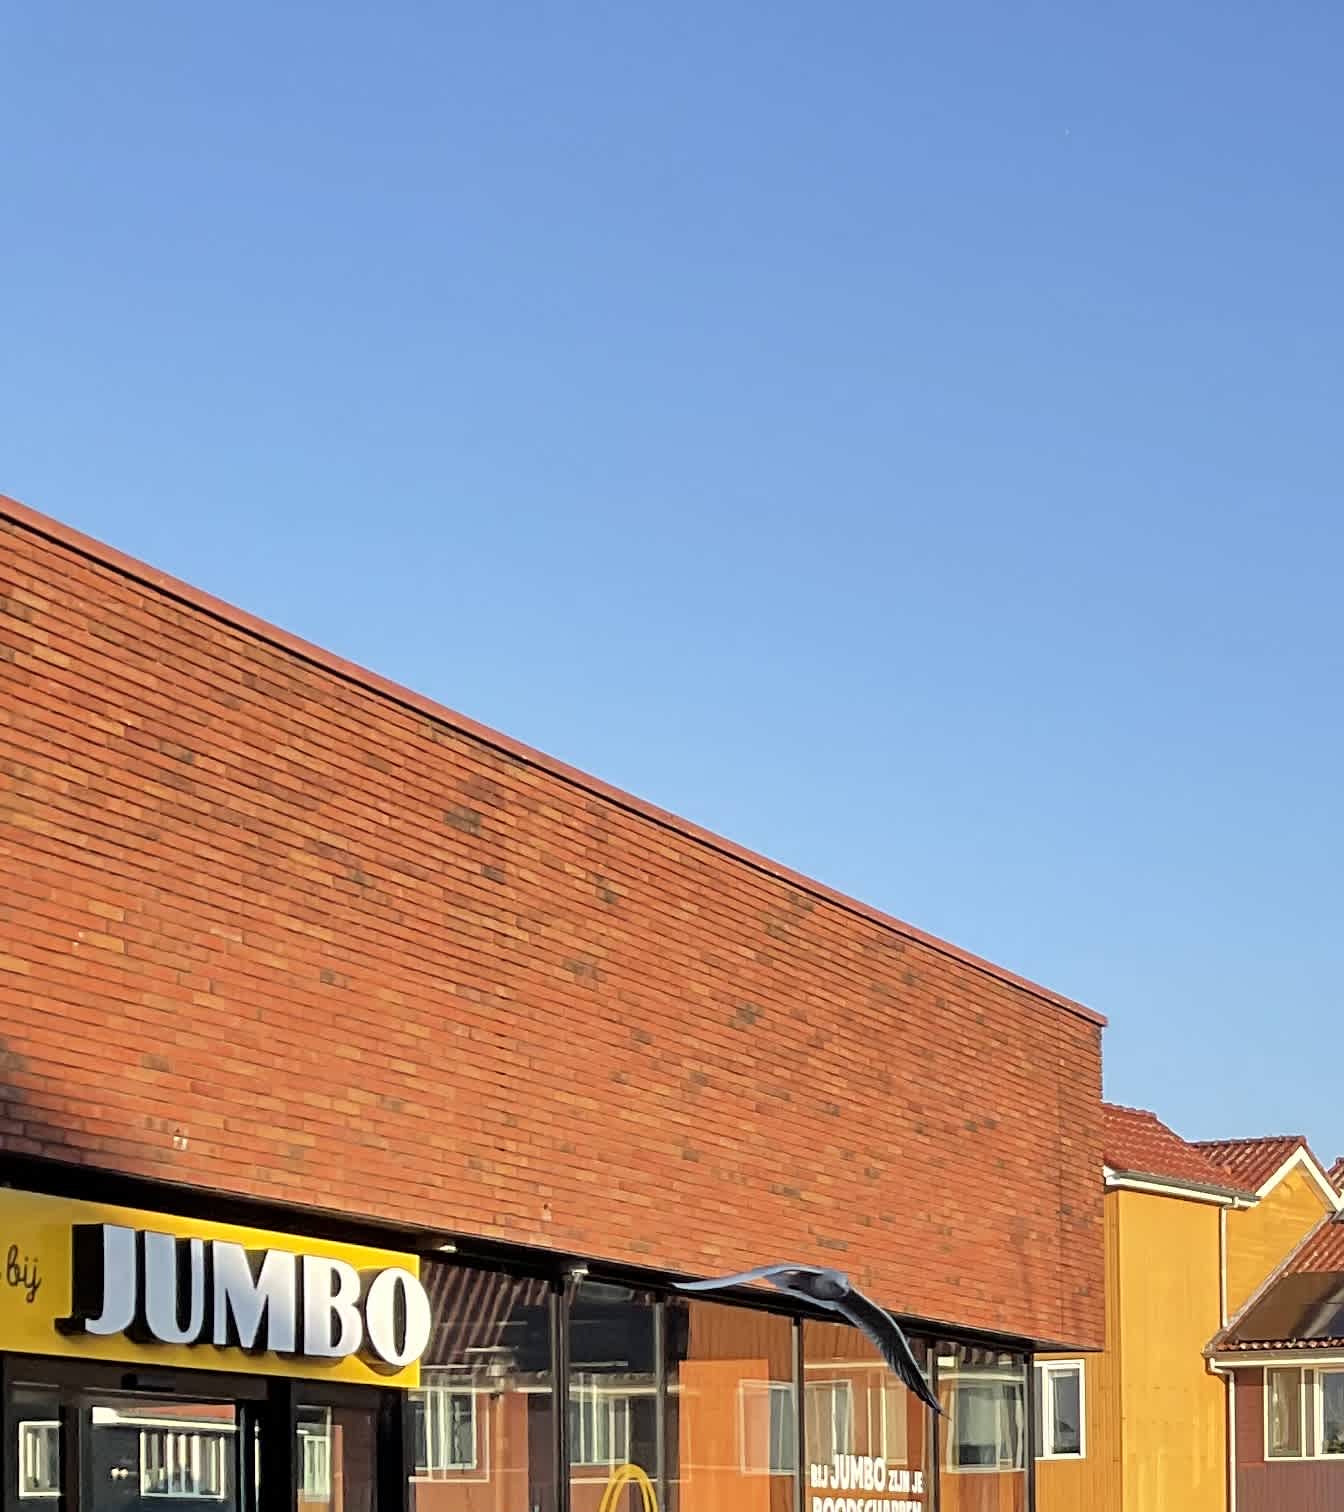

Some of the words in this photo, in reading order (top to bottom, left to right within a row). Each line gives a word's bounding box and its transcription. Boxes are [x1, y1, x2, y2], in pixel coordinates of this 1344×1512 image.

[7, 1244, 42, 1304] bij
[85, 1223, 432, 1367] JUMBO
[830, 1453, 886, 1492] JUMBO
[888, 1469, 910, 1493] ZIJN
[911, 1471, 923, 1493] JE
